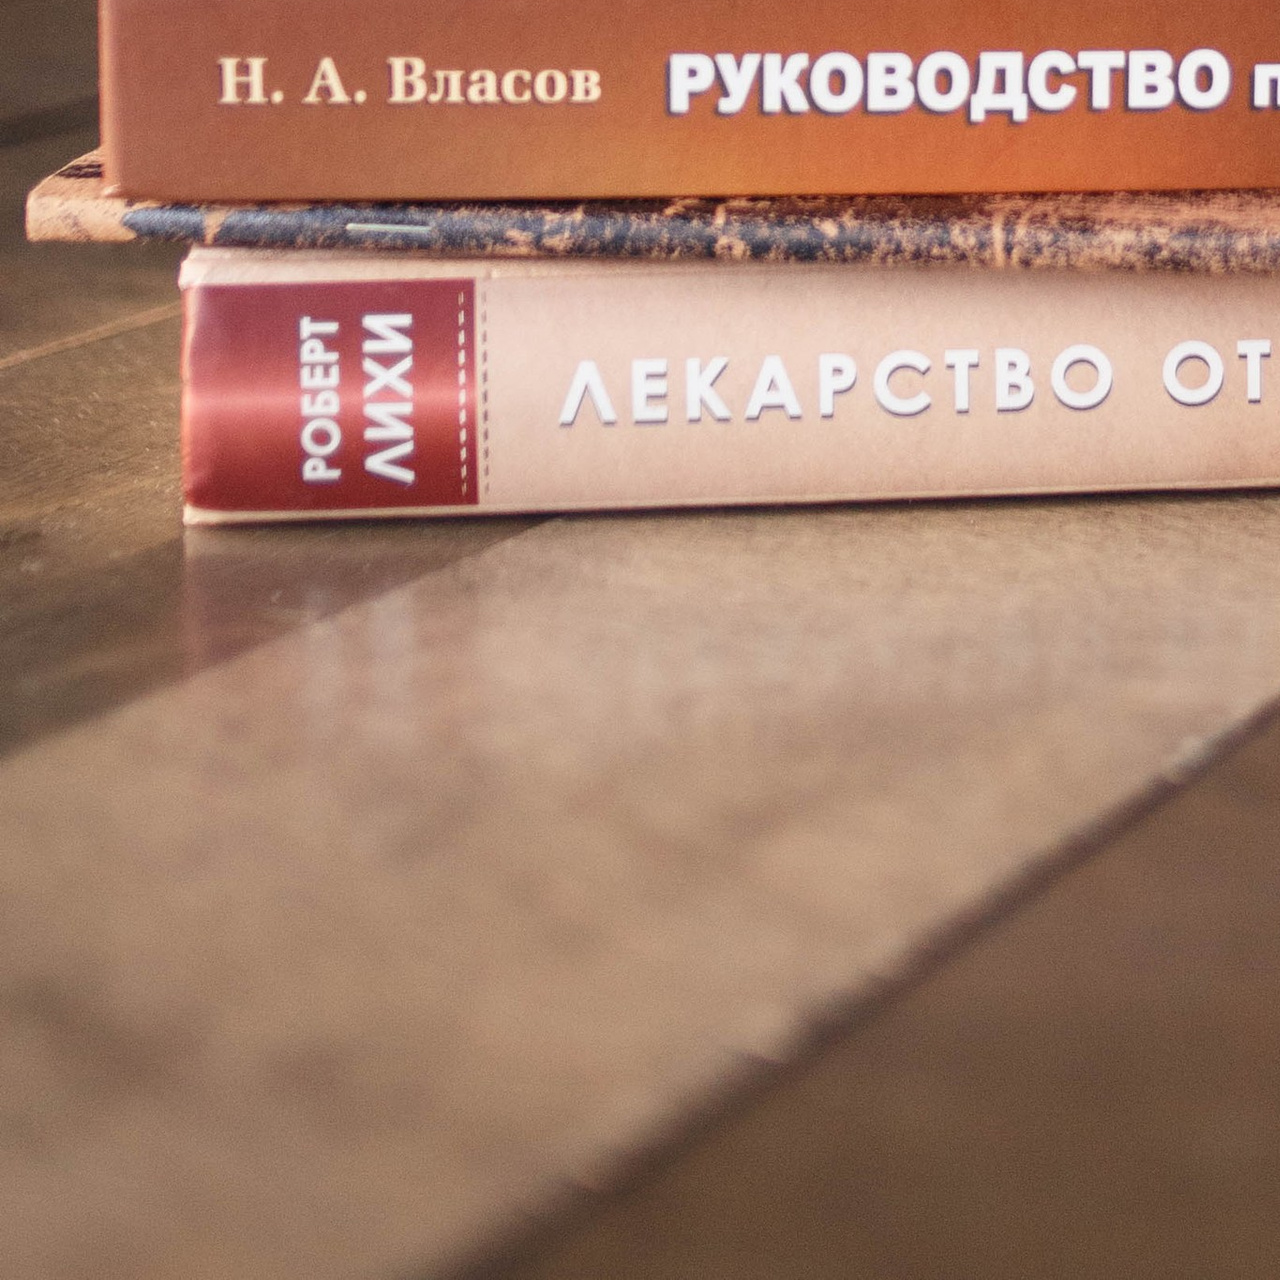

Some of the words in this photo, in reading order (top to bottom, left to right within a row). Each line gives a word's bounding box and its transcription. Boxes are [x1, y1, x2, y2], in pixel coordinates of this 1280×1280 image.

[217, 56, 285, 104] Н.
[302, 56, 368, 104] А.
[386, 56, 603, 104] Власов
[667, 48, 1231, 123] РУКОВОДСТВО
[300, 315, 342, 484] РОБЕРТ
[362, 312, 416, 485] ЛИХИ
[558, 343, 1115, 428] ЛЕКАРСТВО
[1161, 339, 1272, 406] ОТ
